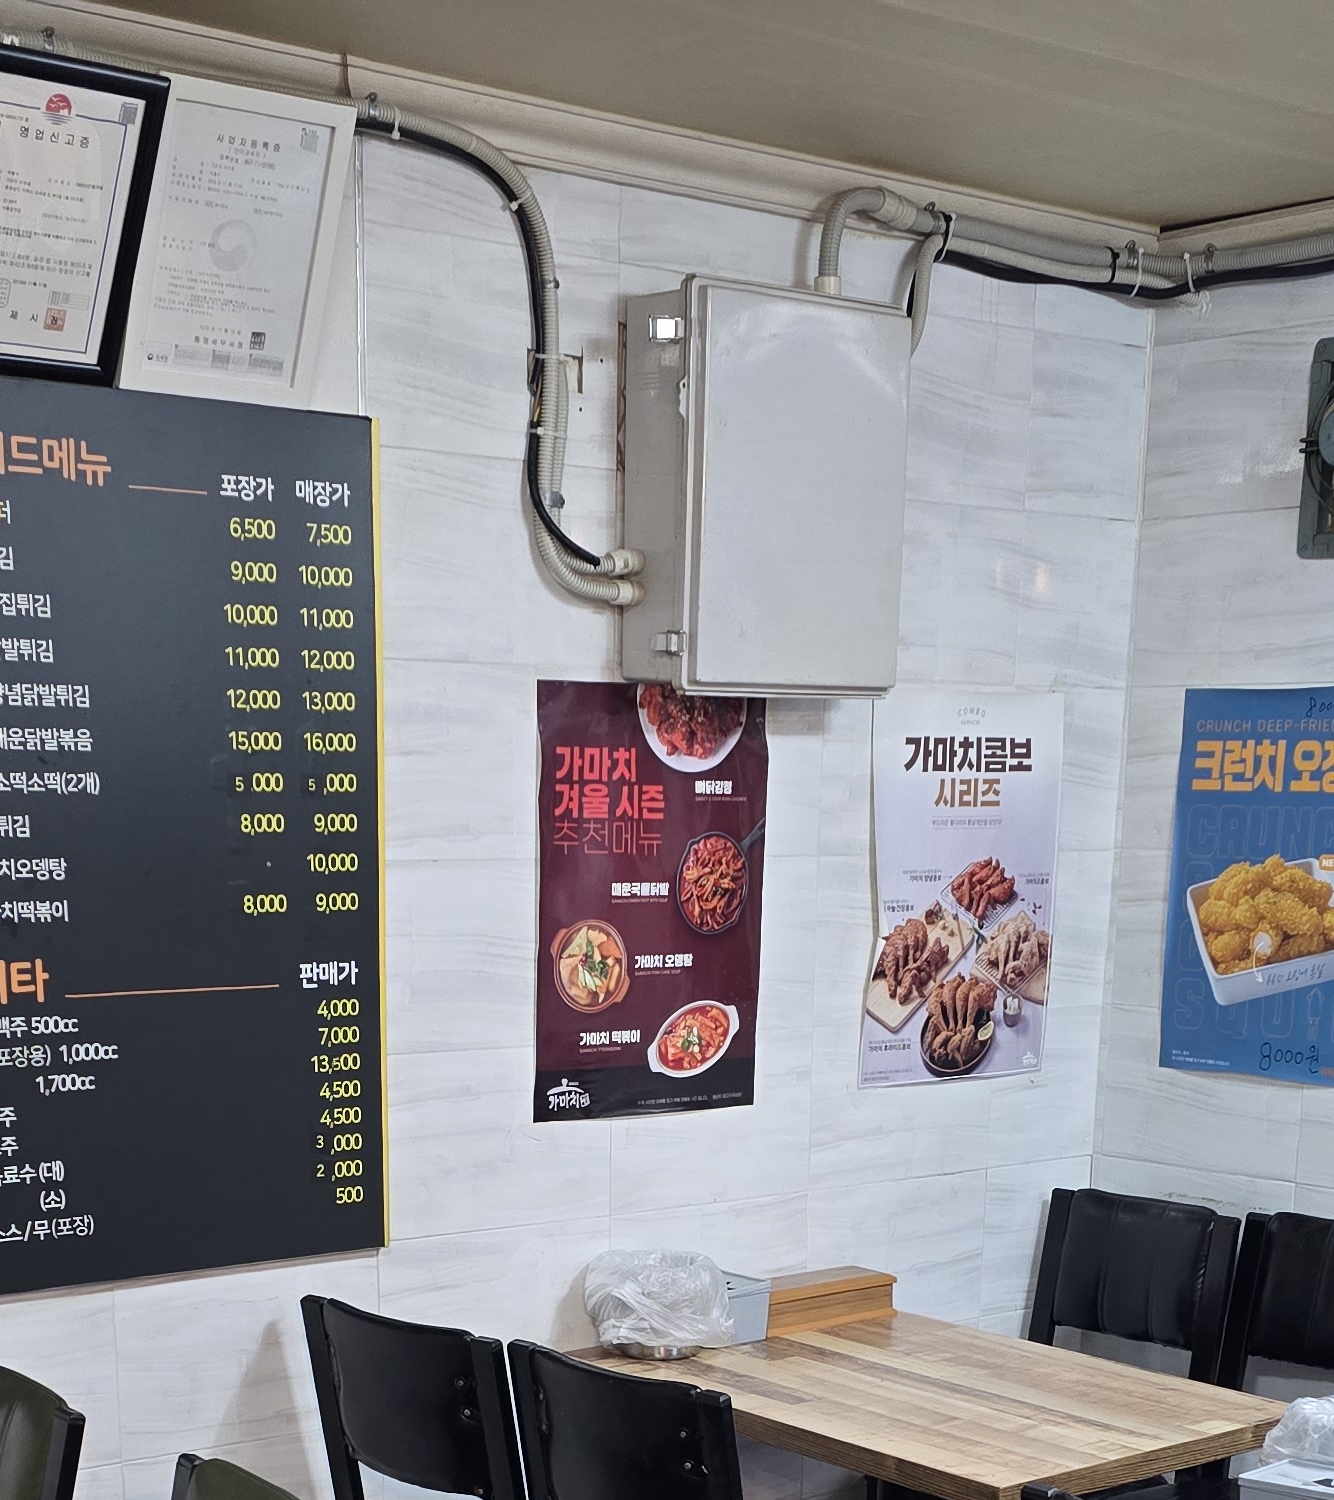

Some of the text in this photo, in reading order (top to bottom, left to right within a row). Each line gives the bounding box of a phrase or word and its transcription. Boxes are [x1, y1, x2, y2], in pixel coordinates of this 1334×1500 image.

[20, 126, 90, 148] 영업신고증
[219, 474, 351, 509] 포장가 매장가
[229, 516, 276, 542] 6,500
[306, 522, 352, 547] 7,500
[230, 560, 277, 585] 9,000
[298, 564, 353, 589] 10,000
[223, 603, 278, 628] 10,000
[299, 607, 354, 631] 11,000
[224, 646, 280, 670] 11,000
[300, 649, 355, 673] 12,000
[226, 688, 281, 713] 12,000
[301, 690, 356, 714] 13,000
[957, 706, 986, 718] COMBO
[1197, 719, 1251, 733] CRUNCH
[228, 730, 282, 754] 15,000
[303, 732, 357, 755] 16,000
[904, 736, 1032, 773] 가마치콤보
[555, 747, 637, 781] 가마치
[1192, 739, 1287, 792] 크런치
[554, 783, 665, 820] 겨울 시즌
[934, 777, 1001, 808] 시리즈
[240, 813, 285, 836] 8,000
[313, 813, 358, 836] 9,000
[553, 819, 663, 857] 추천메뉴
[306, 852, 359, 875] 10,000
[243, 893, 288, 917] 8,000
[315, 892, 359, 915] 9,000
[299, 960, 359, 989] 판매가
[634, 955, 663, 969] 가마치
[31, 1016, 79, 1035] 500cc
[316, 998, 360, 1021] 4,000
[58, 1042, 119, 1065] 1,000cc
[317, 1025, 360, 1048] 7,000
[579, 1031, 610, 1046] 가마치
[1259, 1042, 1319, 1074] 8000원
[35, 1052, 361, 1097] 1,700cc 13,500
[319, 1079, 361, 1102] 4,500
[548, 1092, 580, 1111] 가마치
[319, 1106, 362, 1129] 4,500
[39, 1188, 66, 1211] (소)
[335, 1185, 364, 1205] 500
